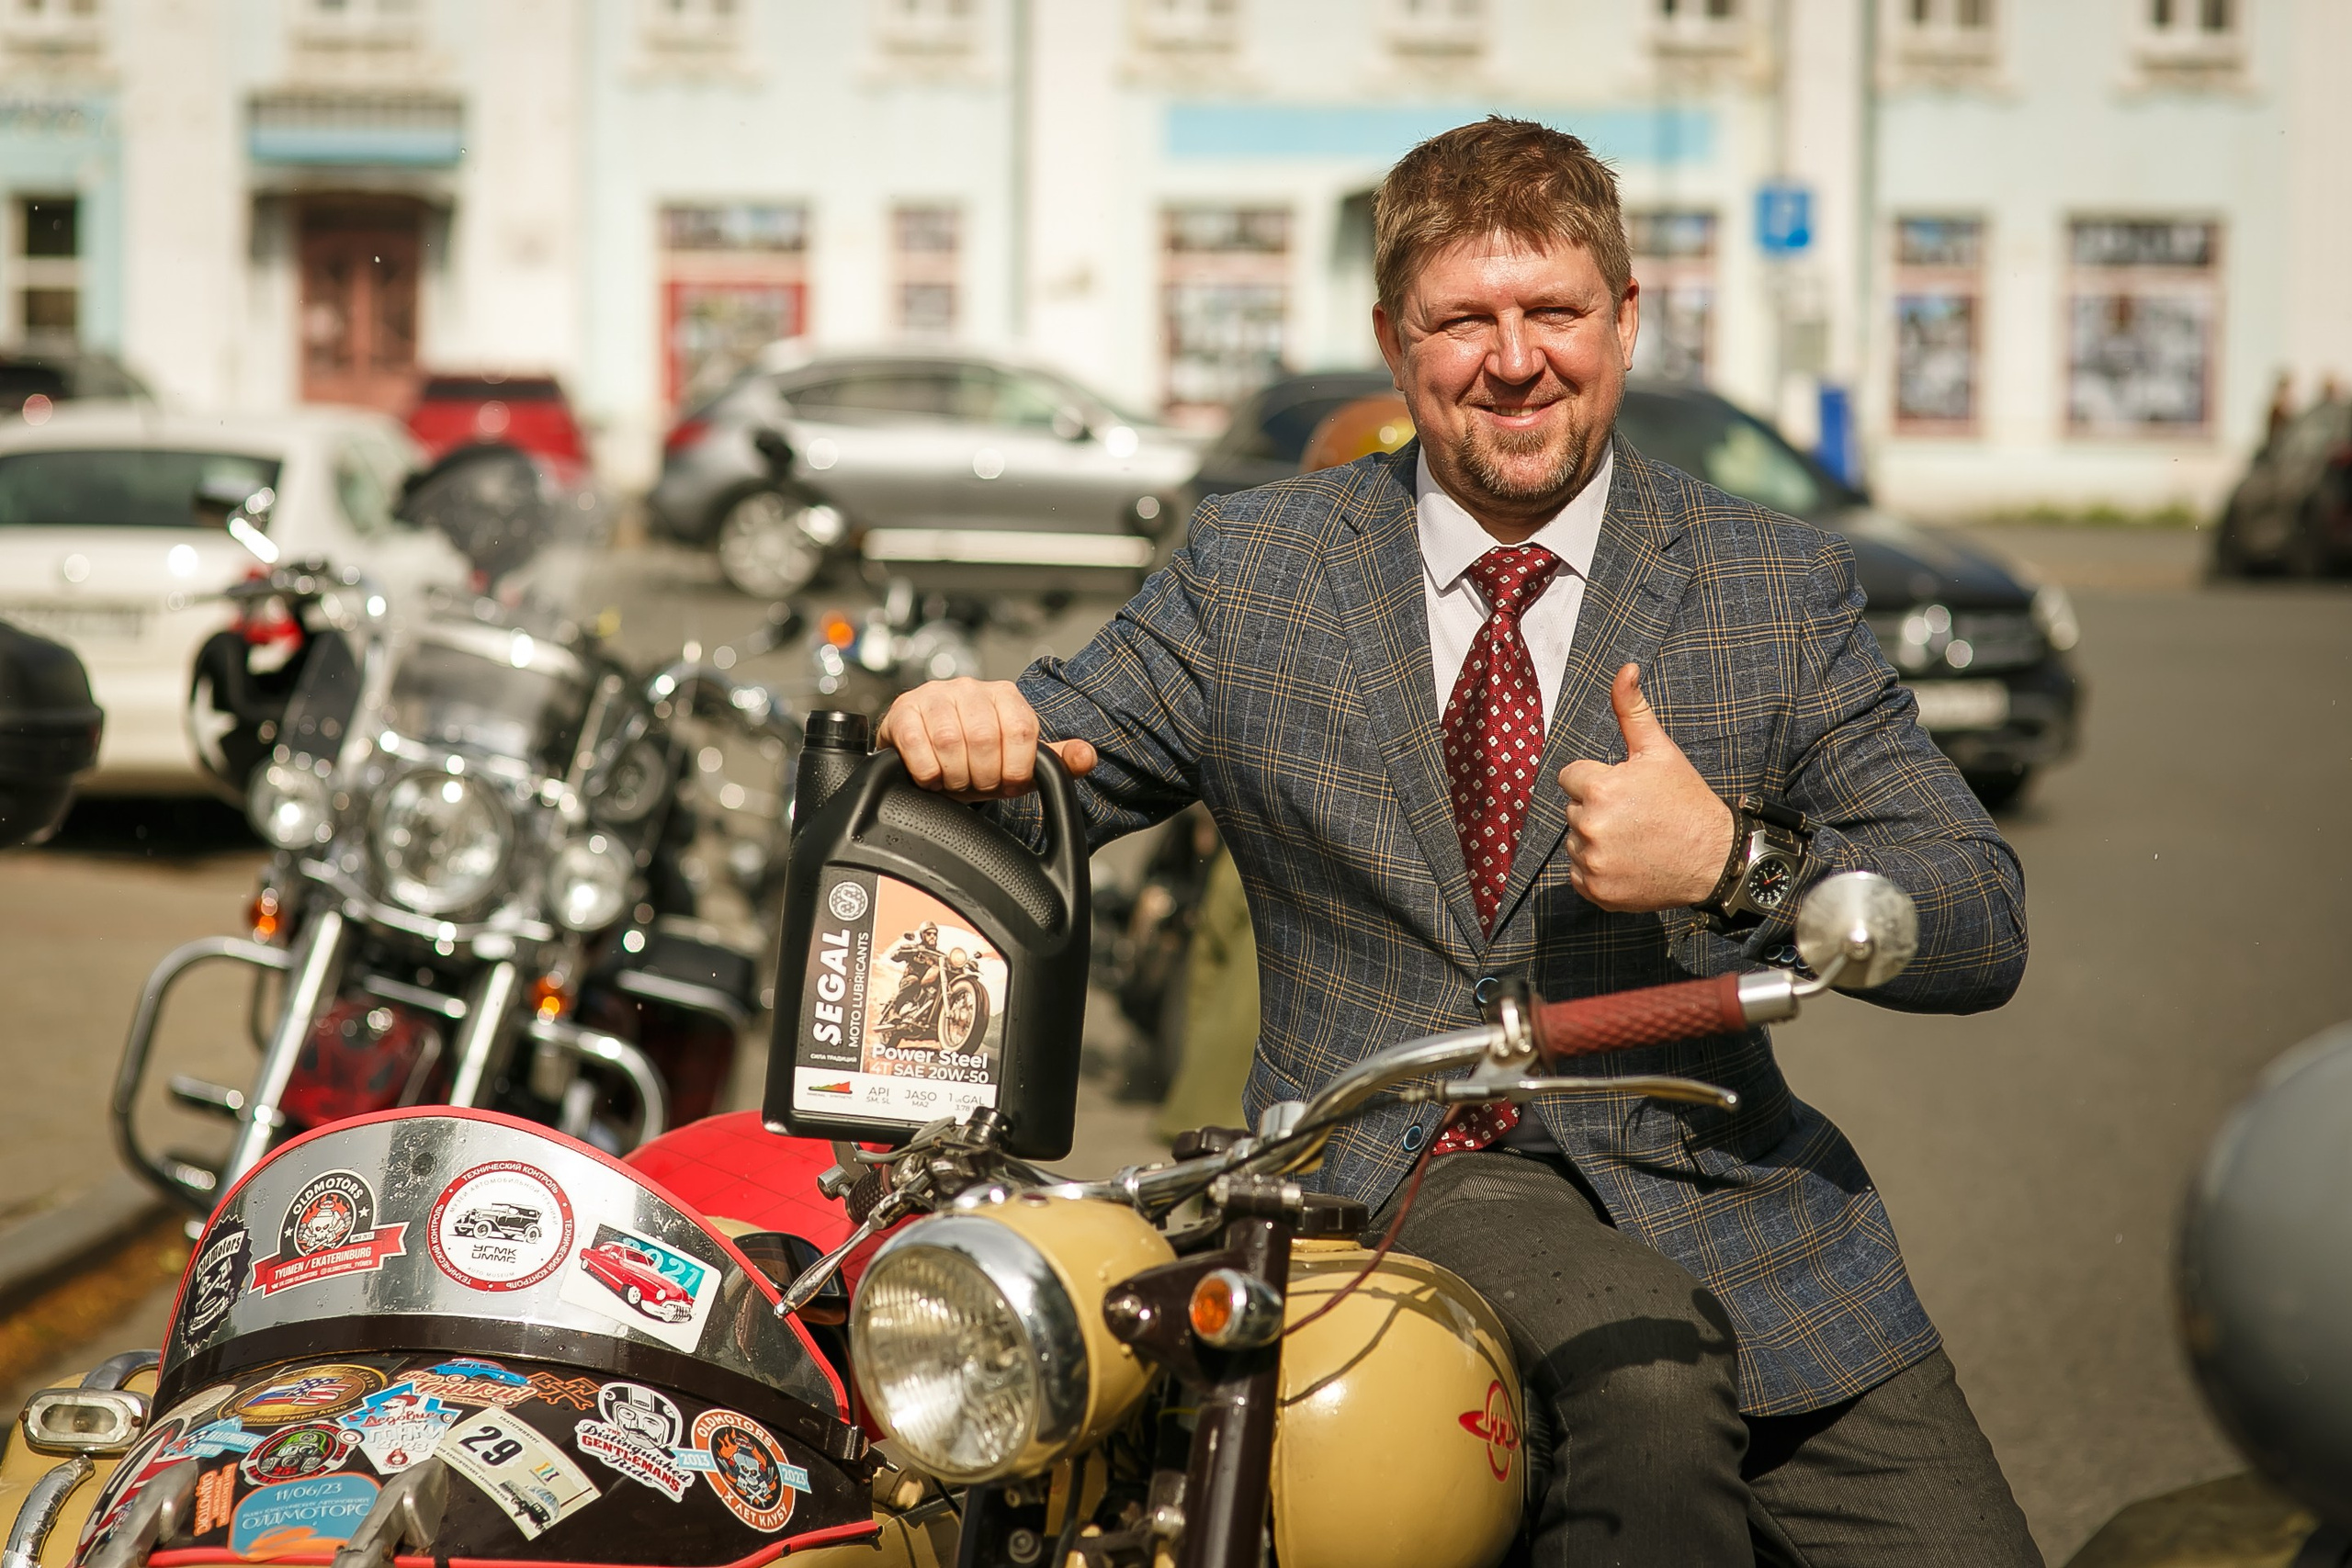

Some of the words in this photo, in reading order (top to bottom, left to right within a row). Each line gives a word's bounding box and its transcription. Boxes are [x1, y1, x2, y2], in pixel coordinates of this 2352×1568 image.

[852, 931, 869, 1009] LUBRICANTS
[812, 928, 851, 1047] SEGAL
[848, 1010, 862, 1048] MOTO
[871, 1043, 935, 1064] Power
[938, 1050, 989, 1069] Steel
[893, 1063, 925, 1078] SAE
[927, 1066, 989, 1084] 20W-50
[868, 1087, 890, 1097] API
[904, 1089, 937, 1101] JASO
[948, 1092, 953, 1102] 1
[962, 1094, 985, 1106] GAL
[461, 1162, 522, 1181] ТЕХНИЧЕСКИЙ
[523, 1166, 559, 1194] КОНТРОЛЬ
[292, 1177, 364, 1215] OLDMOTORS
[449, 1191, 469, 1213] МУЗЕЙ
[469, 1178, 540, 1193] АВТОМОБИЛЬНОЙ
[430, 1204, 445, 1244] КОНТРОЛЬ
[471, 1253, 516, 1264] UMMC
[473, 1244, 518, 1257] УГМК
[547, 1219, 572, 1272] ТЕХНИЧЕСКИЙ
[275, 1261, 305, 1280] TYUMEN
[311, 1247, 372, 1269] EKATERINBURG
[432, 1244, 472, 1285] ТЕХНИЧЕСКИЙ
[506, 1268, 548, 1289] КОНТРОЛЬ
[458, 1426, 524, 1467] 29
[696, 1414, 774, 1447] OLDMOTORS
[579, 1423, 691, 1483] Distinguished
[680, 1452, 710, 1467] 2013
[275, 1482, 343, 1503] 11/06/23
[782, 1467, 807, 1486] 2023
[242, 1504, 370, 1530] ОЛДМОТОРС
[735, 1503, 757, 1523] ЛЕТ
[759, 1503, 787, 1528] КЛУБУ
